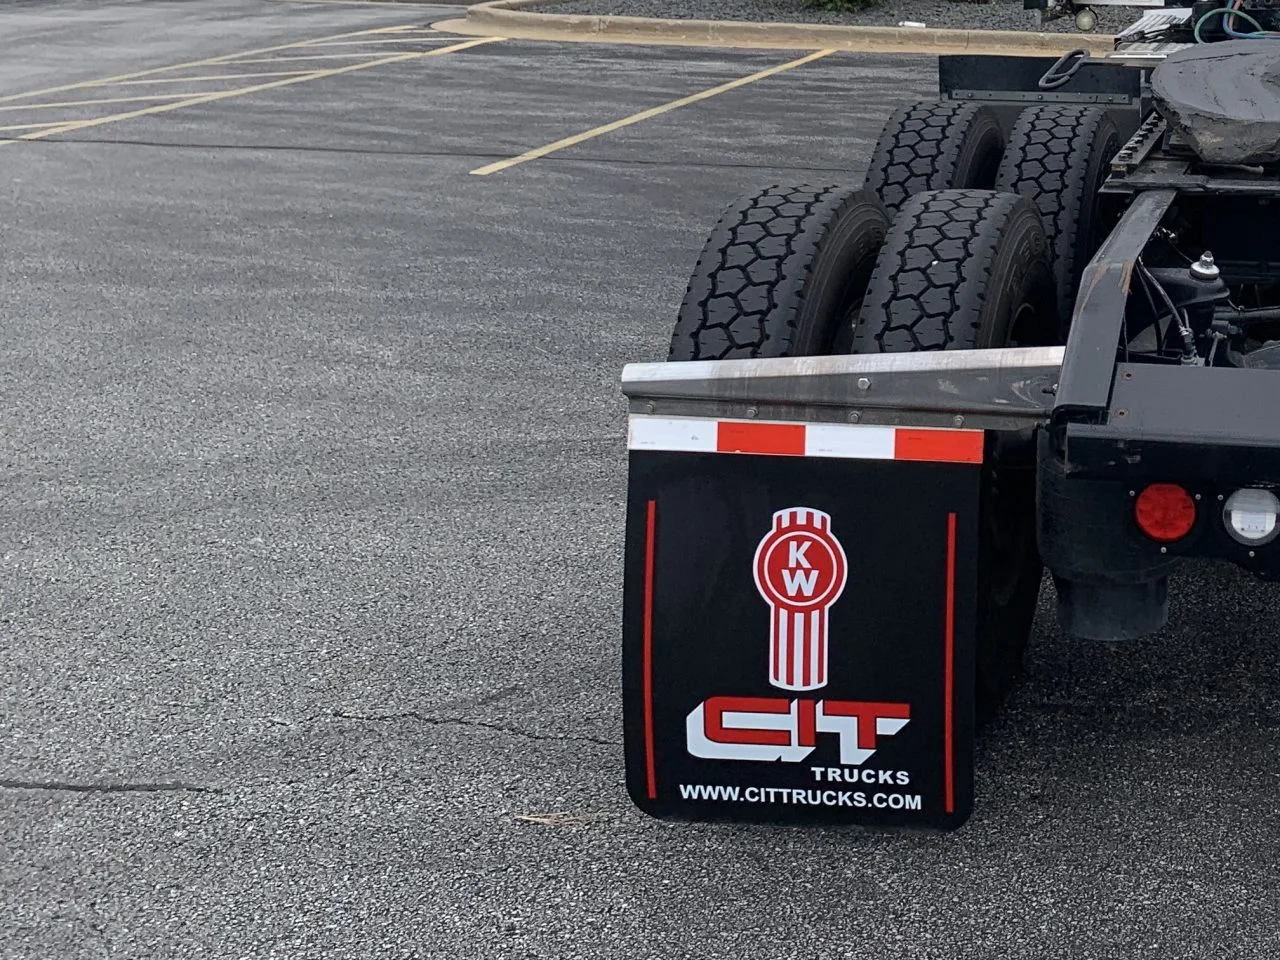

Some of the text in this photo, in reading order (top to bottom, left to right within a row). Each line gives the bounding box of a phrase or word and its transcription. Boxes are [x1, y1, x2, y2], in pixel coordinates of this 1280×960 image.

[788, 540, 812, 569] K
[781, 569, 819, 597] W
[686, 696, 911, 765] CIT
[811, 767, 910, 785] TRUCKS
[680, 784, 922, 810] WWW.CITTRUCKS.COM
